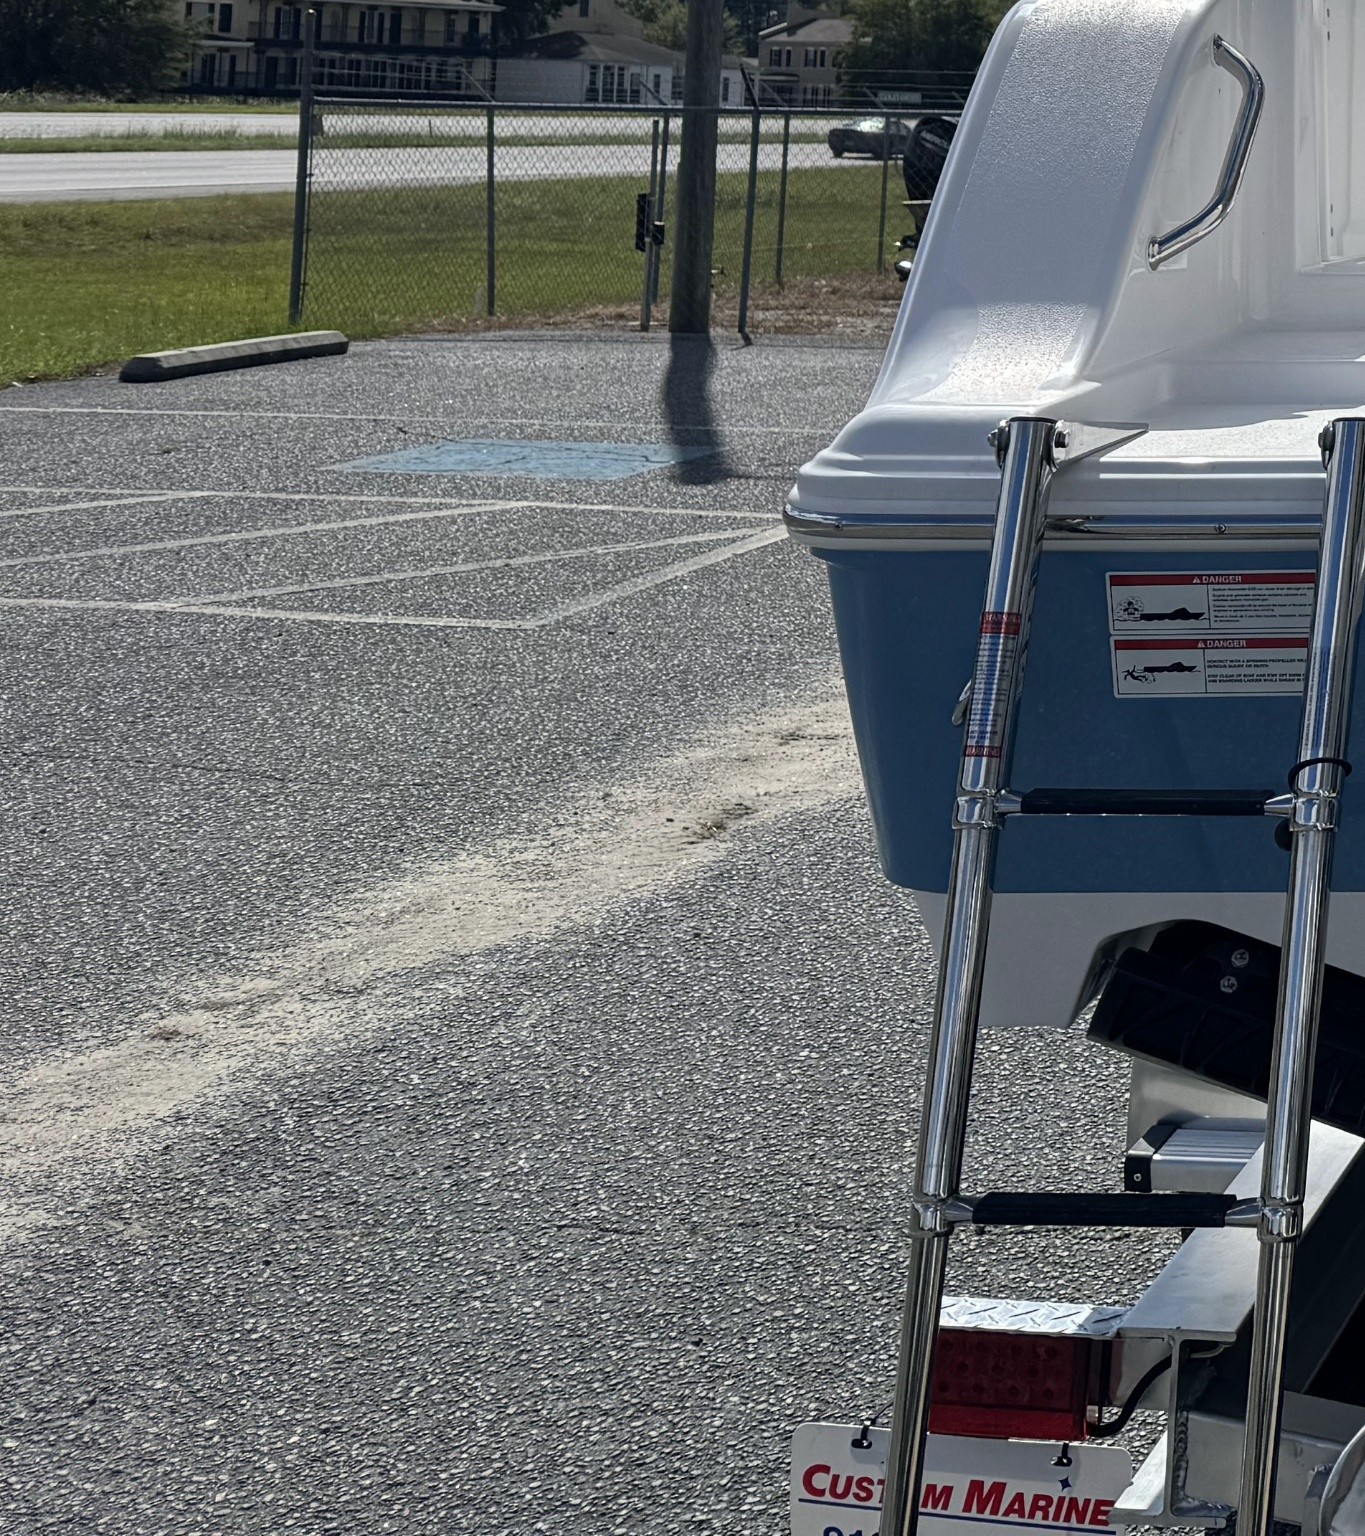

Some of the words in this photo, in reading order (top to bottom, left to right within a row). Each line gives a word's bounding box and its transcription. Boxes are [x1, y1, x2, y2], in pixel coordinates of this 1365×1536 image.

[1202, 575, 1242, 583] DANGER
[1206, 639, 1247, 648] DANGER
[962, 1479, 1116, 1526] MARINE
